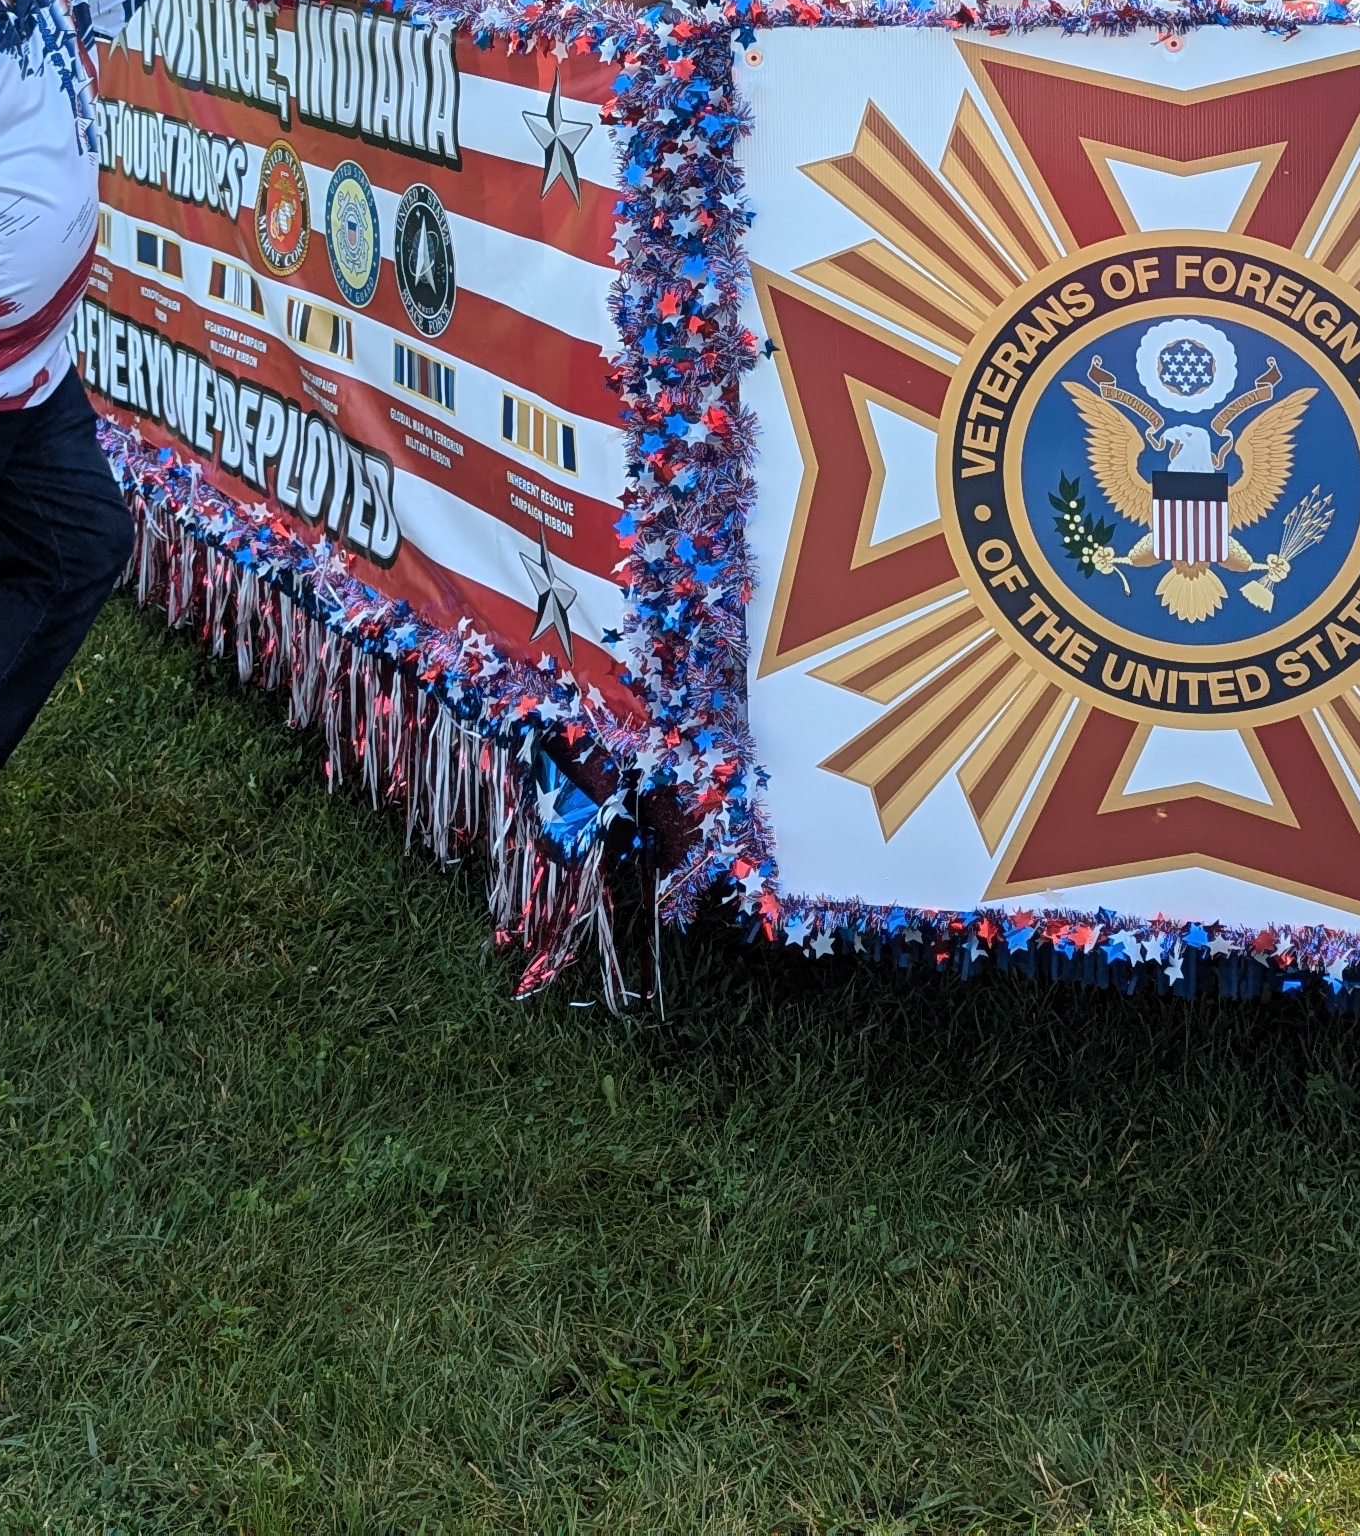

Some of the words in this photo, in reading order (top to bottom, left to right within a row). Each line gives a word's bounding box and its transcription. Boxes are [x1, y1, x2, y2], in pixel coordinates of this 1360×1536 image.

[295, 1, 458, 160] INDIANA
[120, 105, 162, 187] OUR
[161, 117, 246, 221] TROOPS
[329, 167, 352, 195] UNITED
[236, 350, 258, 368] RIBBON
[238, 332, 267, 353] CAMPAIGN
[961, 282, 1095, 479] VETERANS
[1100, 256, 1160, 300] OF
[85, 300, 214, 454] EVERYONE
[217, 375, 400, 560] DEPLOYED
[390, 407, 412, 429] GLOBAL
[412, 417, 424, 433] WAR
[1219, 391, 1259, 423] UNUM
[507, 470, 540, 499] INHERENT
[540, 487, 574, 517] RESOLVE
[510, 493, 543, 521] CAMPAIGN
[544, 515, 574, 538] RIBBON
[977, 539, 1030, 593] OF
[1017, 592, 1099, 674] THE
[1101, 652, 1271, 706] UNITED
